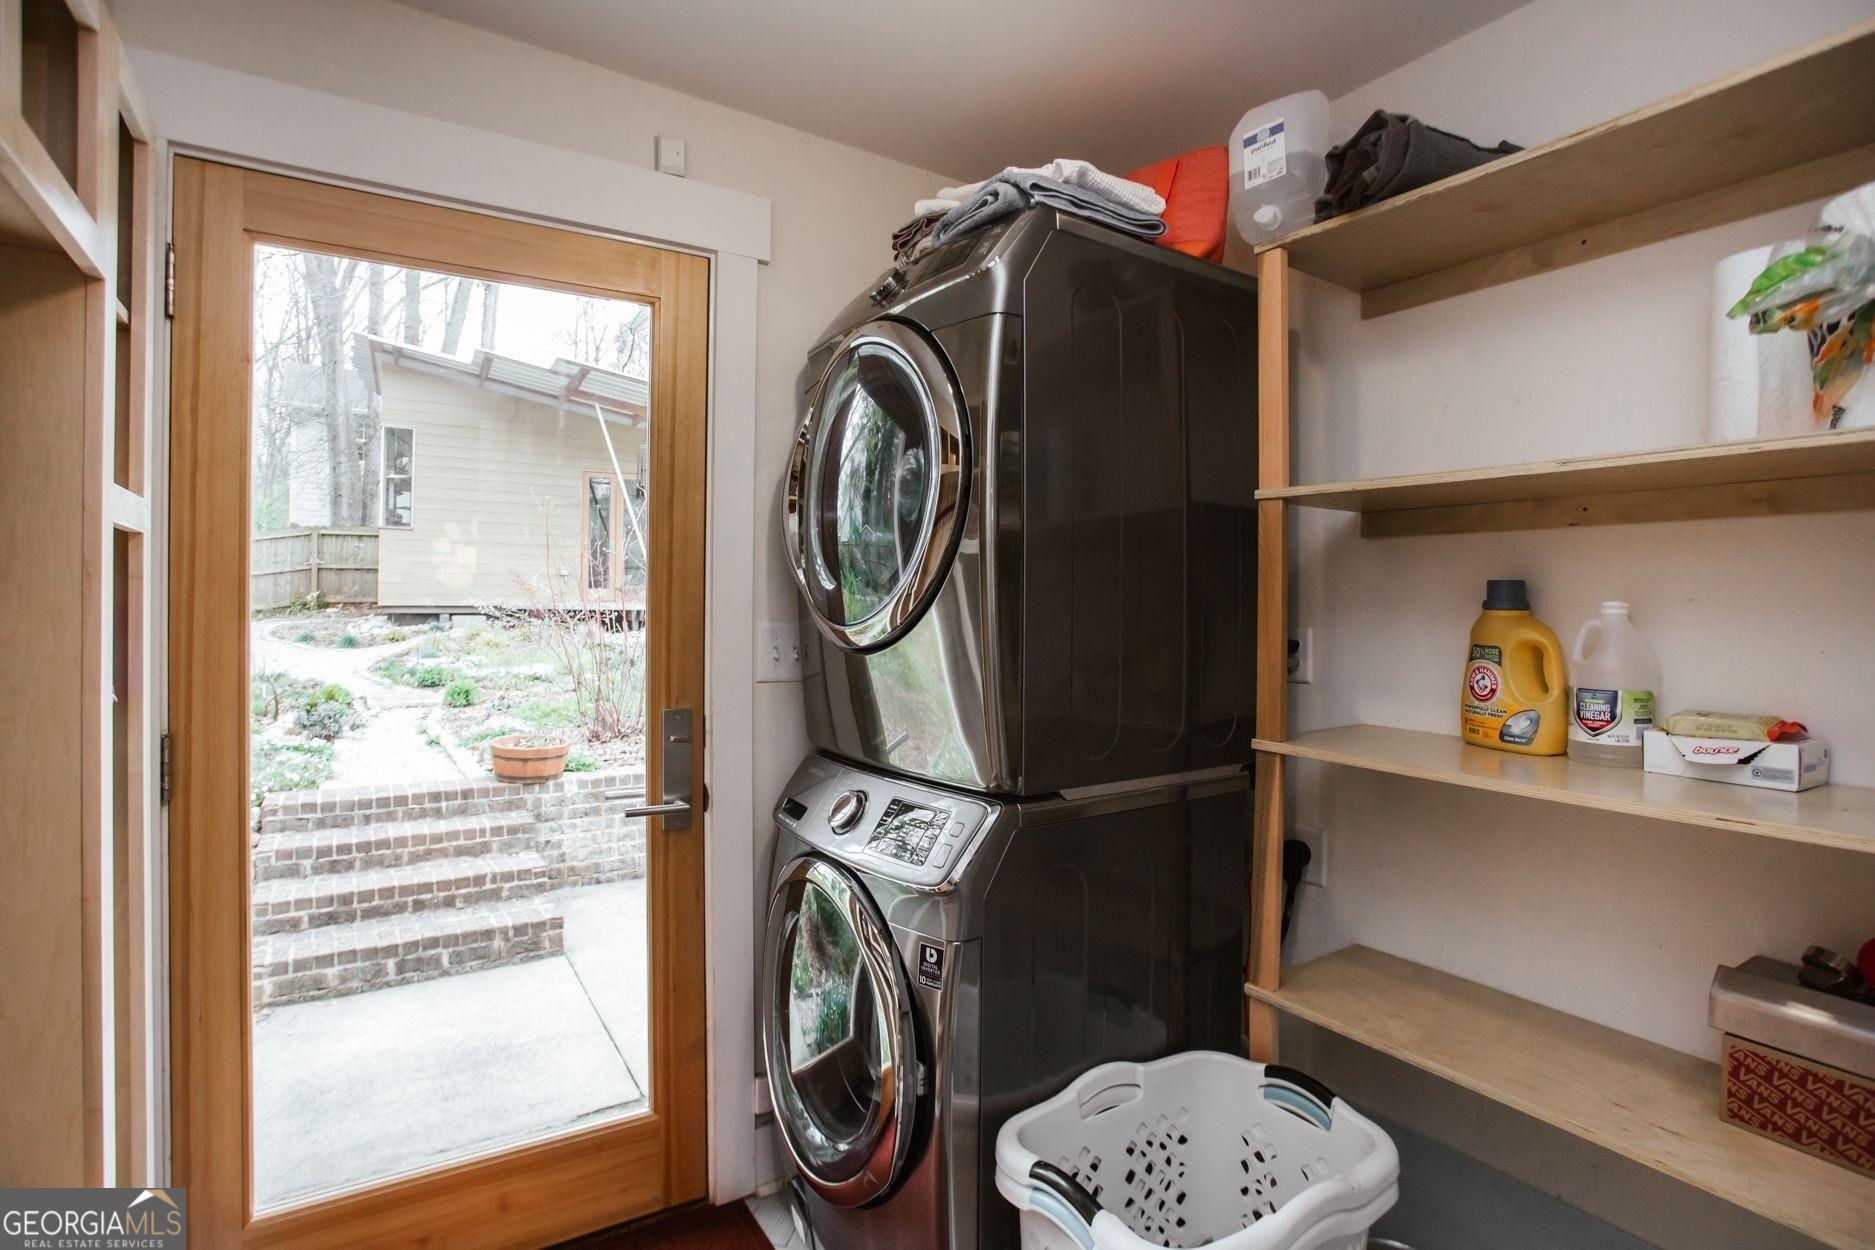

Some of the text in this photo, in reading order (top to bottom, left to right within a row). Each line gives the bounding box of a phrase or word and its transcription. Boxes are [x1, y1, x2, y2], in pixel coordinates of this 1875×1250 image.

[1579, 710, 1611, 721] VINEGAR
[1580, 702, 1611, 712] CLEANING
[1692, 745, 1740, 755] bounce
[919, 975, 926, 984] 10
[1773, 1071, 1820, 1110] VANS
[1822, 1105, 1872, 1147] VANS
[1806, 1075, 1857, 1115] VANS
[1843, 1081, 1875, 1113] VAN
[1740, 1066, 1785, 1104] VANS
[1786, 1100, 1835, 1140] VANS
[1836, 1136, 1875, 1171] VAN
[1753, 1095, 1799, 1134] VANS
